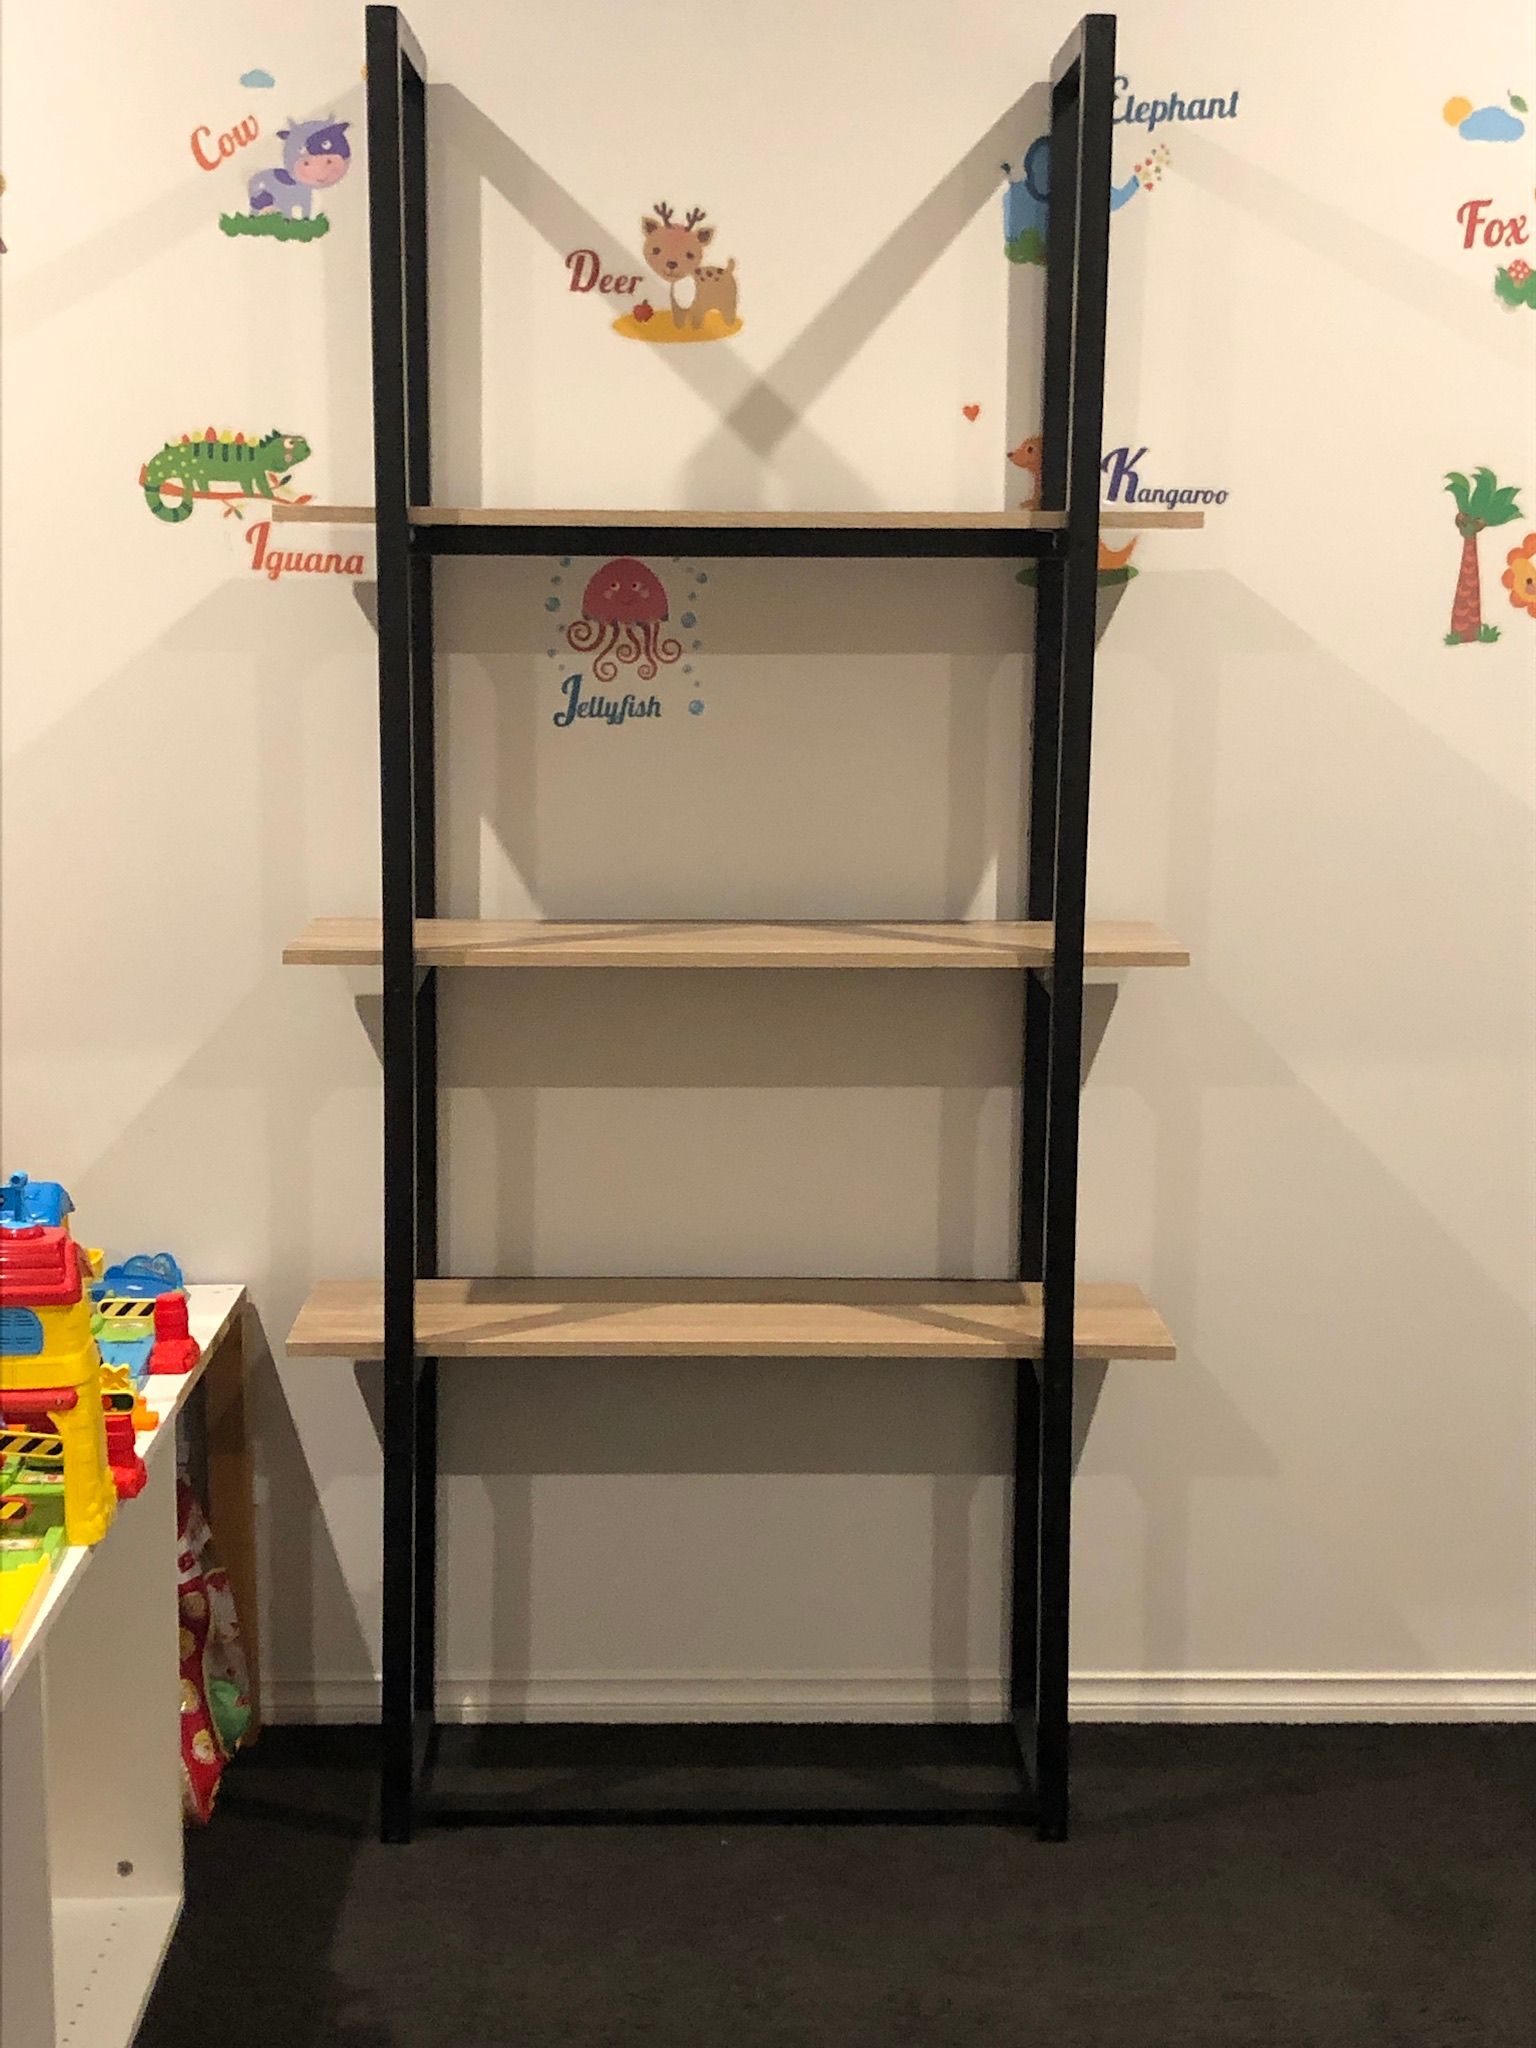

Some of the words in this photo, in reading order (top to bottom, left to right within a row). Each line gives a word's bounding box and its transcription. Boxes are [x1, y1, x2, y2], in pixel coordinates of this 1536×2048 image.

[190, 114, 260, 171] Cow
[1456, 198, 1530, 249] Fox
[565, 249, 643, 294] Deer
[1101, 447, 1229, 510] Kangaroo
[246, 521, 364, 580] Iguana
[553, 674, 661, 727] Jellyfish
